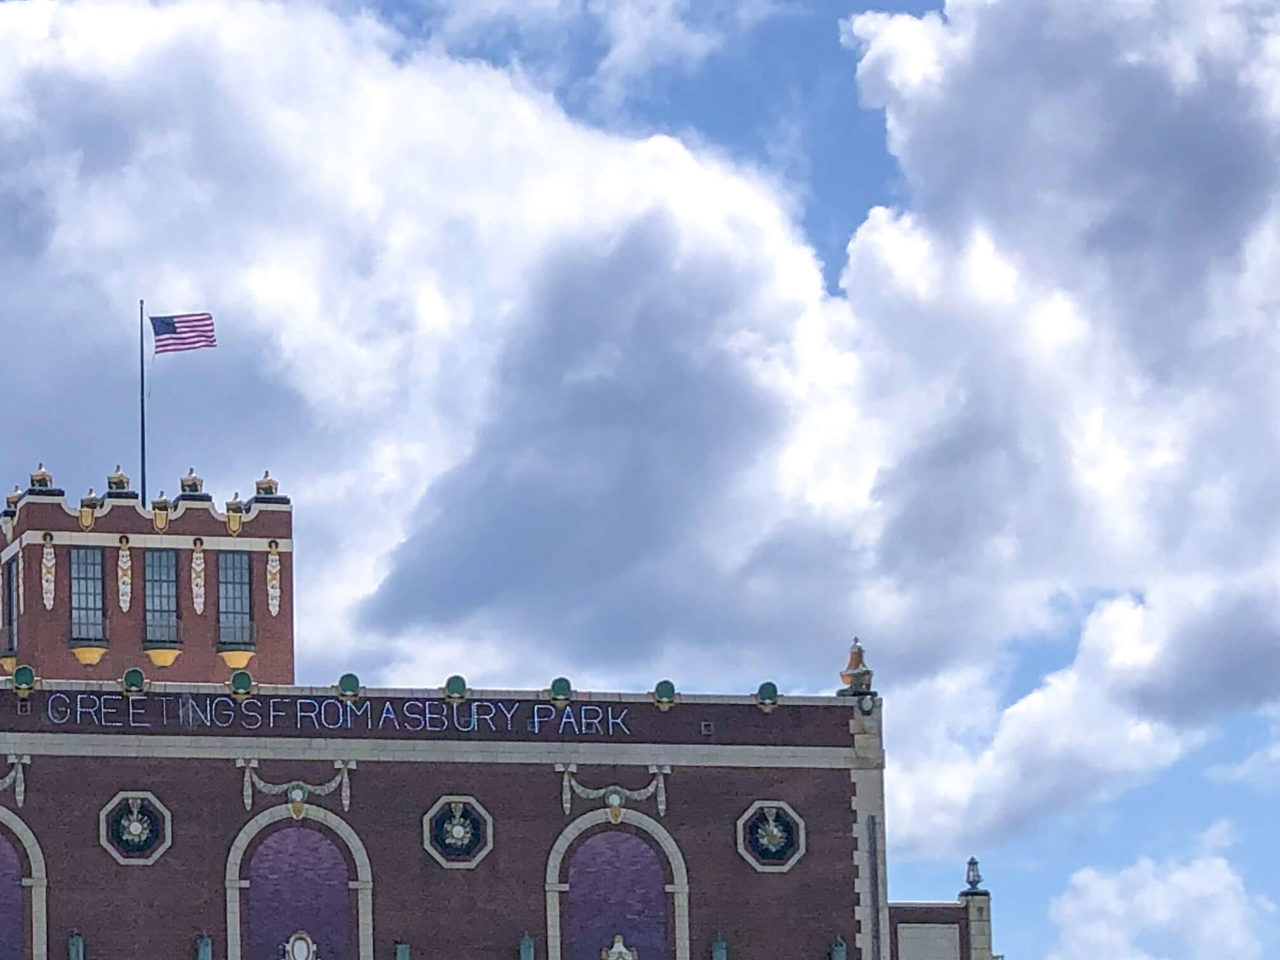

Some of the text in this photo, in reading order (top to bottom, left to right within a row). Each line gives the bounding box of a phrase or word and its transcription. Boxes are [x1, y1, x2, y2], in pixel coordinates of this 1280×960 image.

[48, 693, 630, 735] GREETINGS FROM ASBURY PARK
